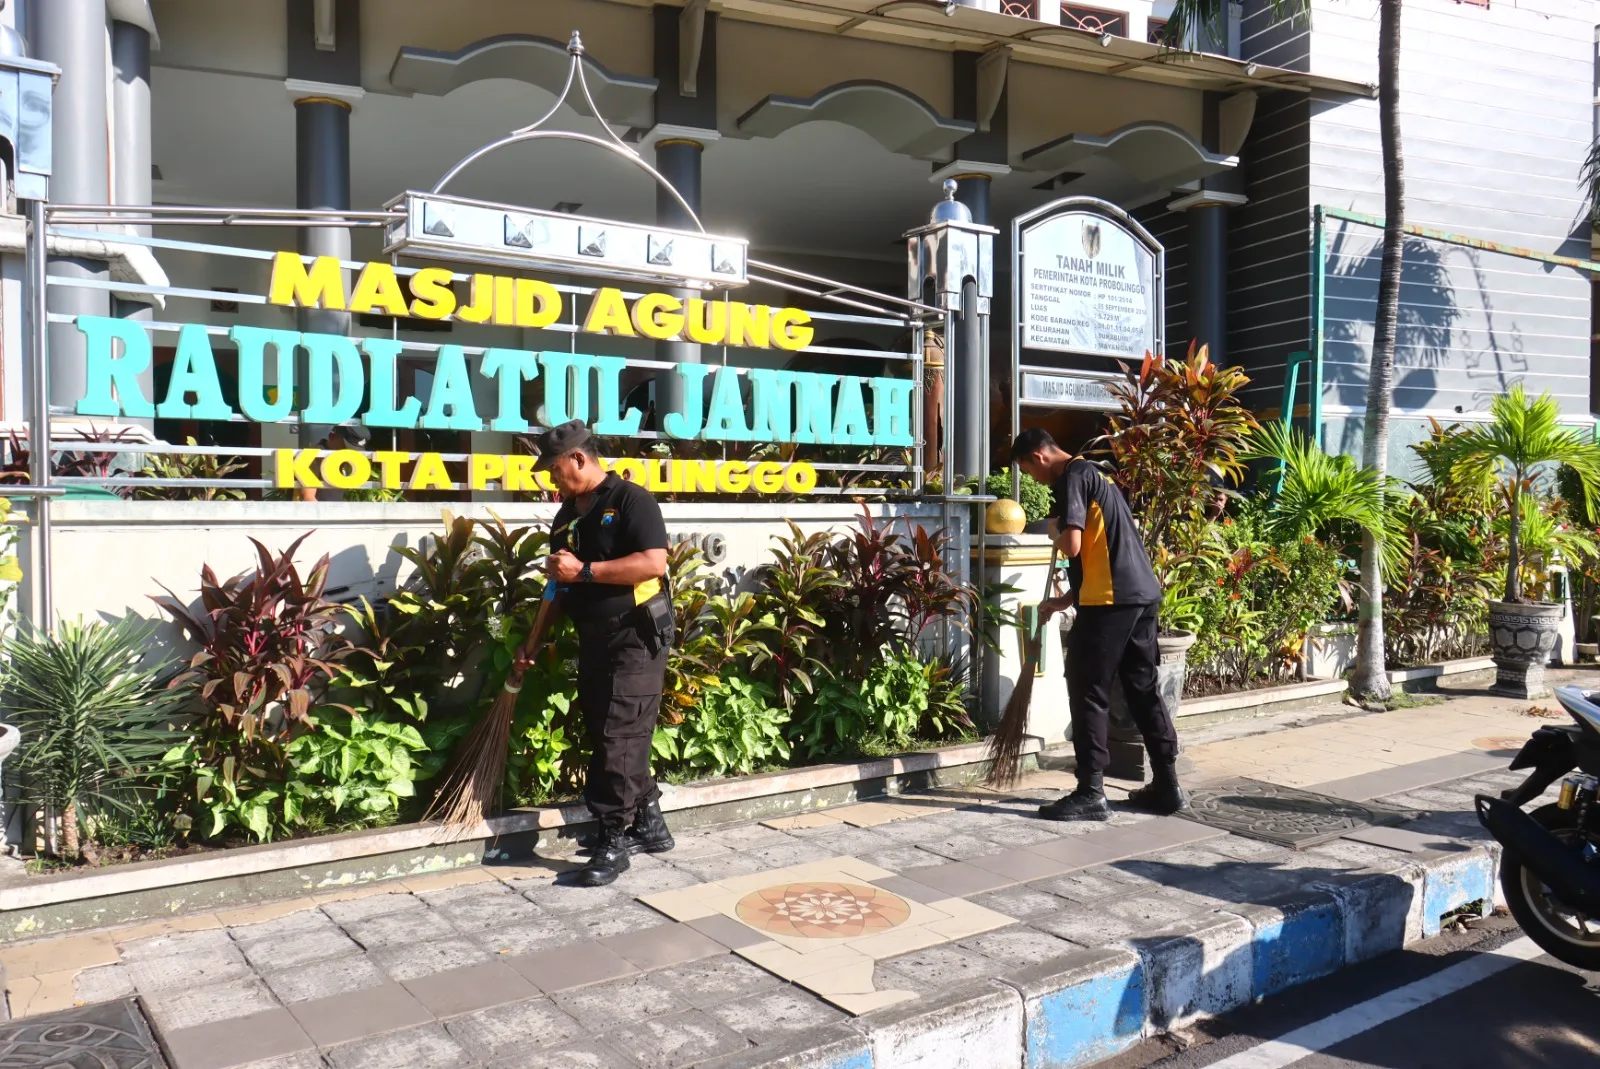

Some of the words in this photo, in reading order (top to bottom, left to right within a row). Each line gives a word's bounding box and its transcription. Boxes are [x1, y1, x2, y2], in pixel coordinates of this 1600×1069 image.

[1056, 254, 1093, 274] TANAH
[1096, 261, 1126, 279] MILIK
[1031, 283, 1067, 294] SERTIFIKAT
[1069, 289, 1091, 298] NOMOR
[1034, 268, 1079, 284] PEMERINTAH
[1080, 275, 1098, 288] KOTA
[1099, 278, 1146, 295] PROBOLINGGO
[268, 251, 563, 328] MASJID
[584, 287, 814, 350] AGUNG
[1031, 293, 1060, 303] TANGGAL
[1105, 303, 1135, 314] SEPTEMBER
[1031, 304, 1048, 312] LUAS
[1031, 314, 1049, 322] KODE
[1031, 324, 1070, 335] KELURAHAN
[1031, 335, 1070, 345] KECAMATAN
[1098, 343, 1133, 352] MAYANGAN
[75, 315, 642, 436] RAUDLATUL
[664, 362, 914, 446] JANNAH
[1043, 381, 1063, 396] MASJID
[1065, 383, 1085, 397] AGUNG
[274, 448, 453, 490] KOTA
[468, 453, 817, 493] PROLINGGO
